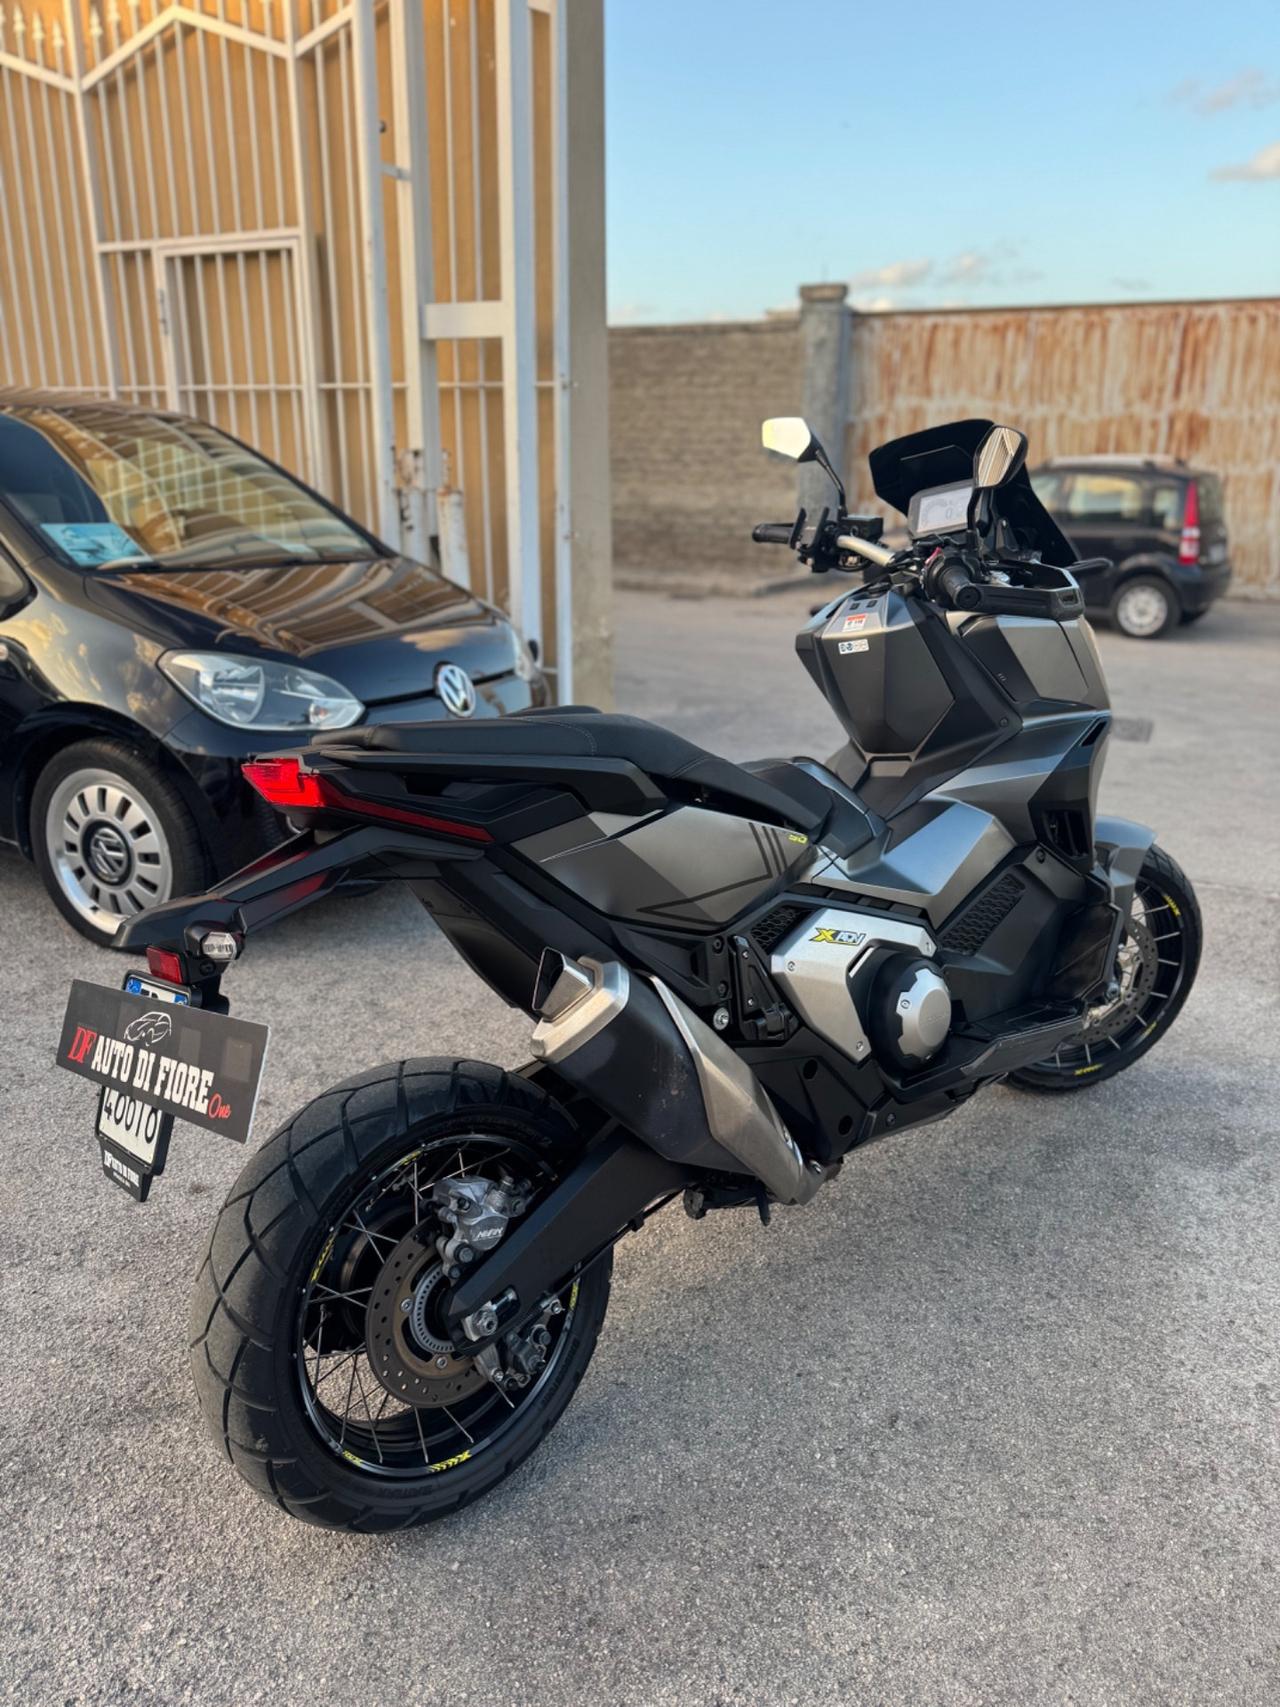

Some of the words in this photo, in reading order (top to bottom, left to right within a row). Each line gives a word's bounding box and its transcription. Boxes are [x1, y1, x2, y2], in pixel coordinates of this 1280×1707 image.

[68, 1027, 97, 1063] DF
[91, 1035, 135, 1080] AUTO
[132, 1048, 156, 1092] DI
[154, 1056, 215, 1115] FIORE
[209, 1093, 231, 1118] One
